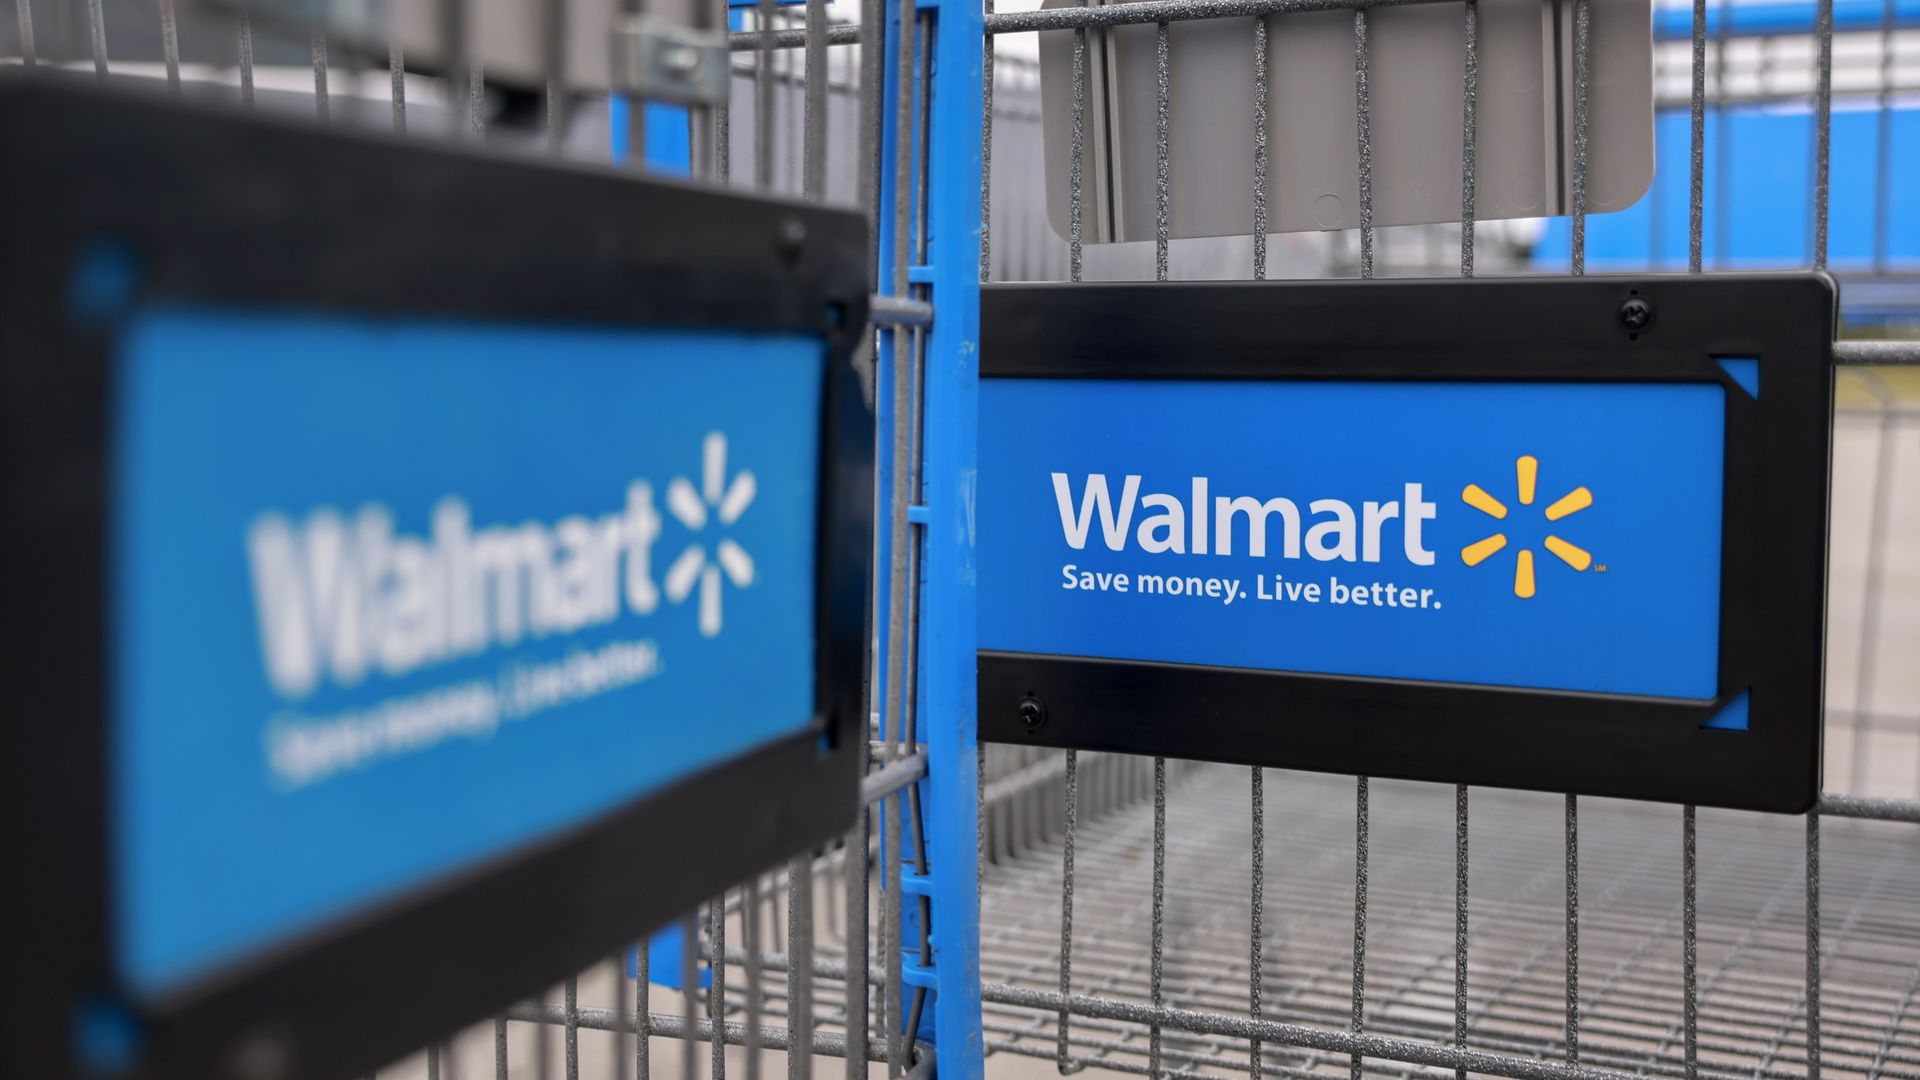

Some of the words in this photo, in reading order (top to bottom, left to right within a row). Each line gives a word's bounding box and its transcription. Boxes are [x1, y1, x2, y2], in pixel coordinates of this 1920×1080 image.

[1051, 472, 1437, 566] Walmart
[250, 482, 661, 696] Walmart
[1062, 564, 1130, 592] Save
[1137, 574, 1247, 605] money.
[1257, 574, 1321, 603] Live
[1330, 576, 1442, 610] better.
